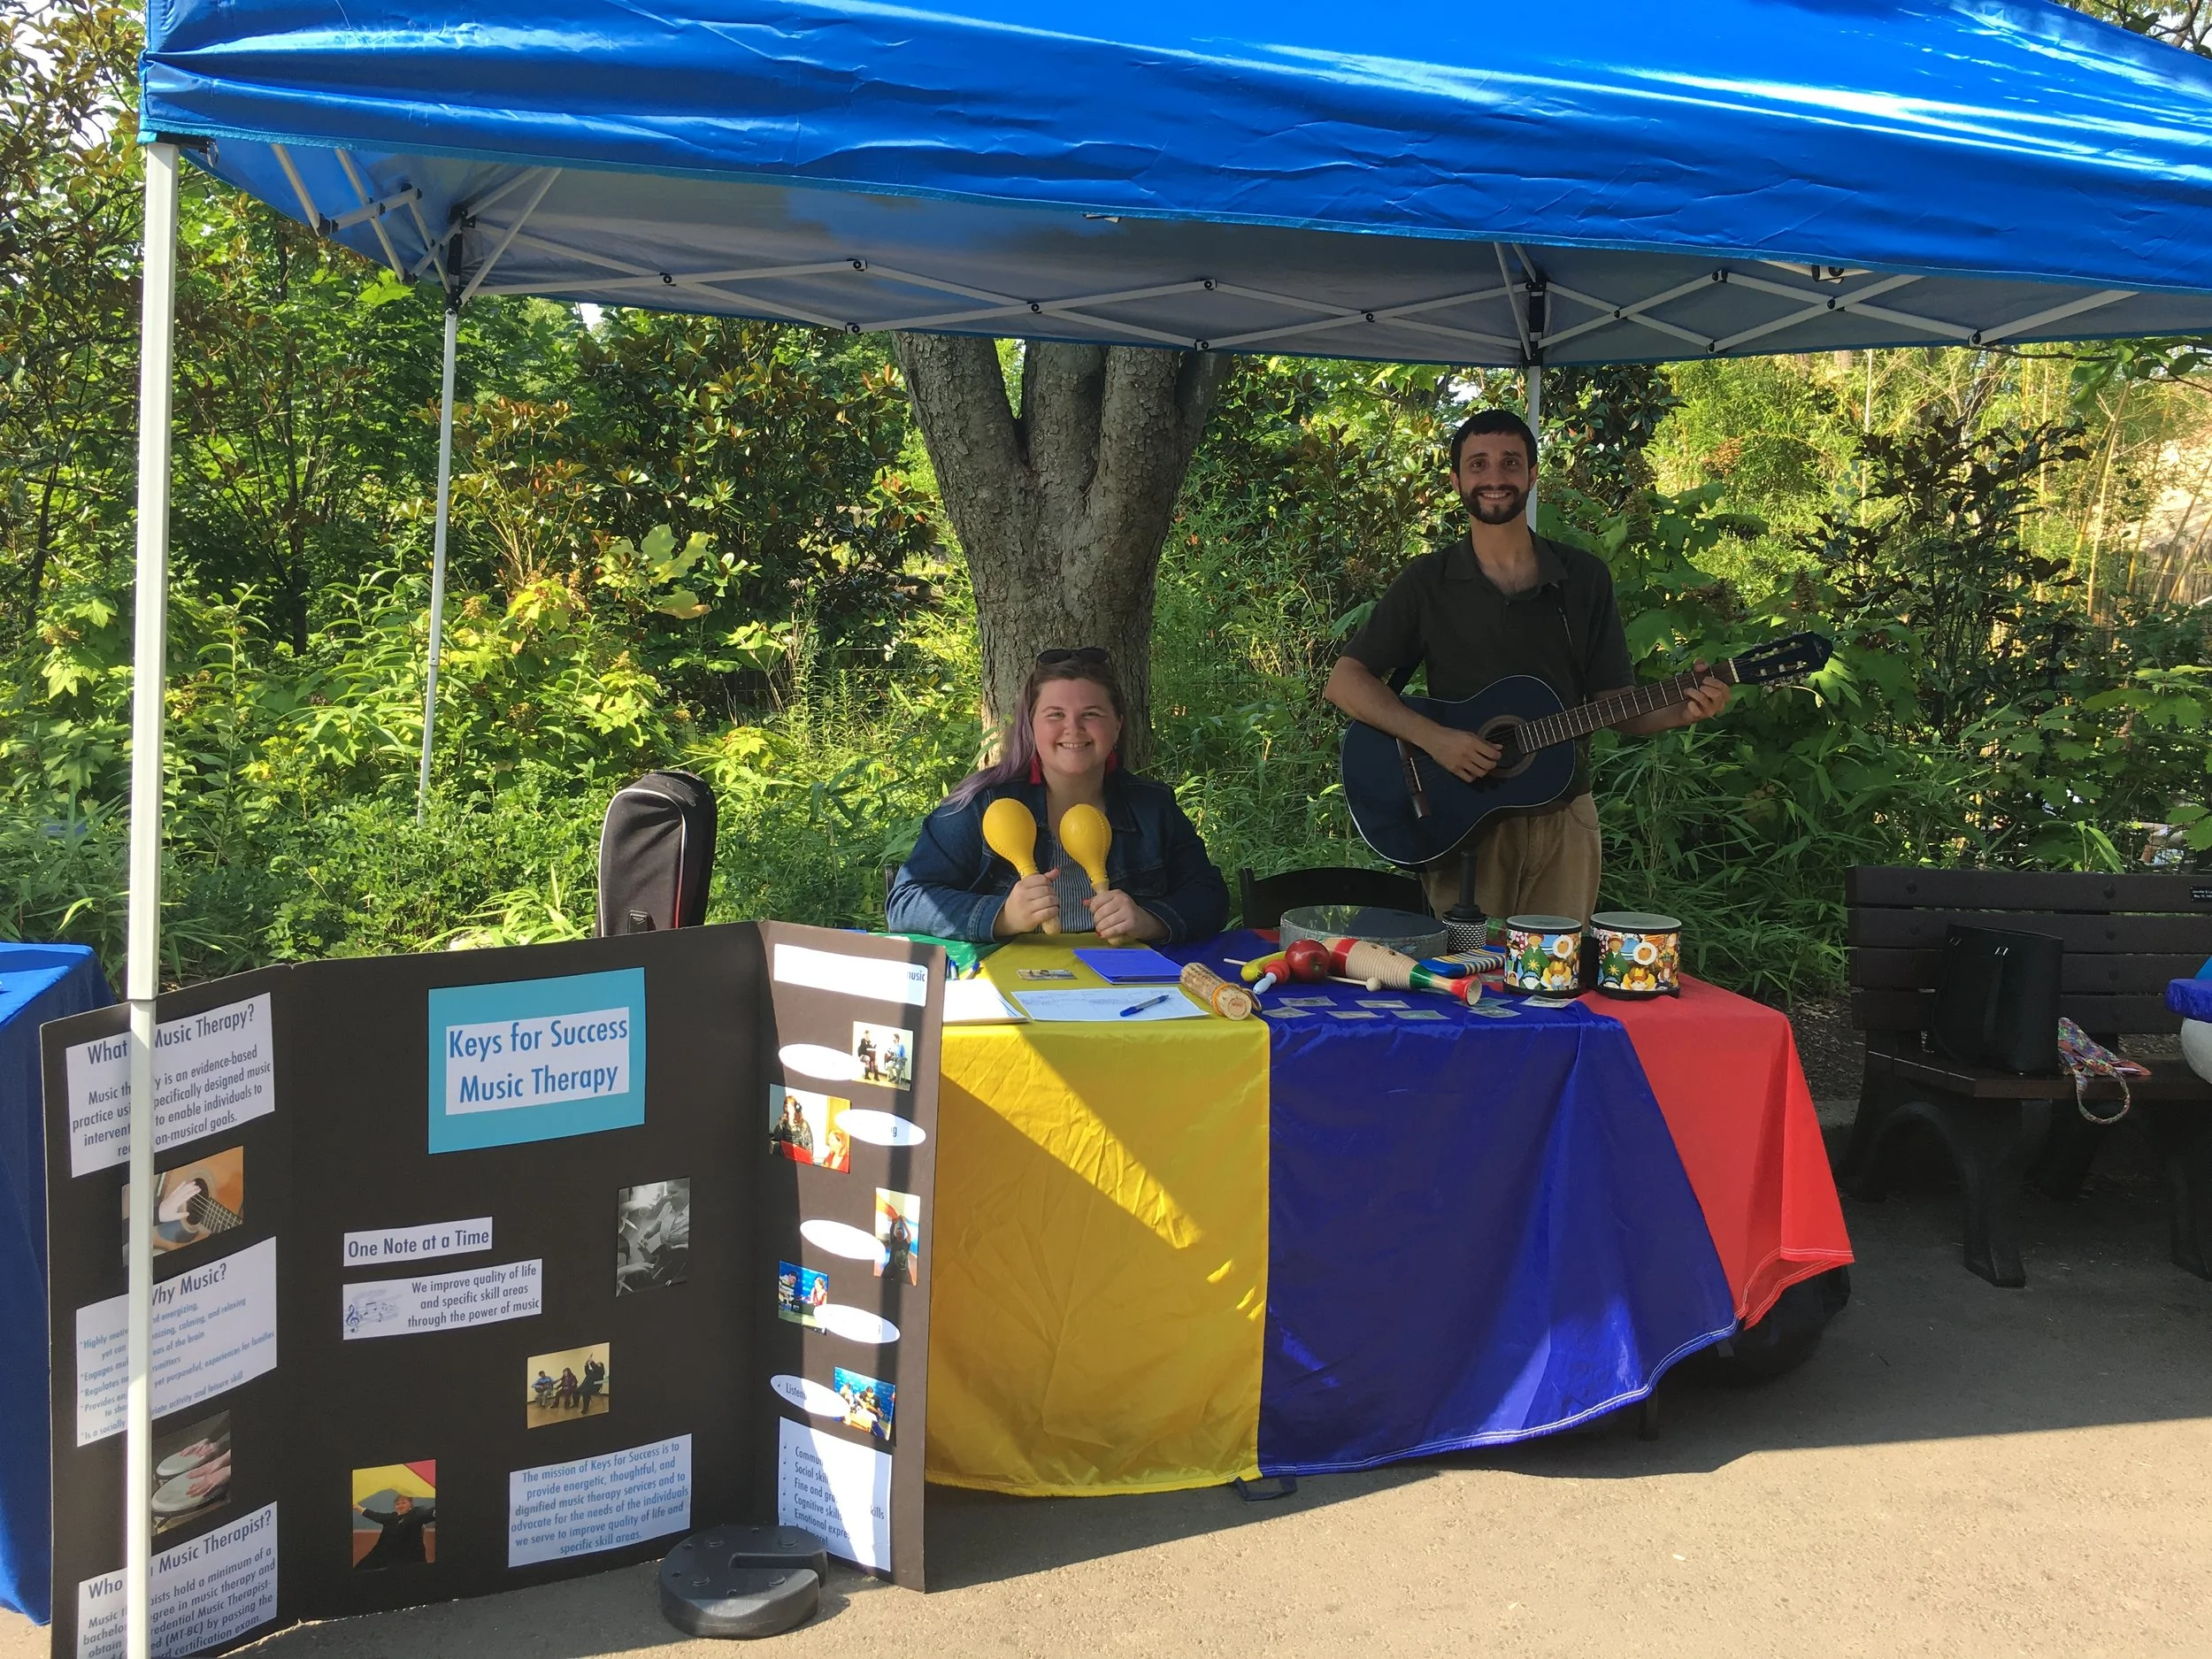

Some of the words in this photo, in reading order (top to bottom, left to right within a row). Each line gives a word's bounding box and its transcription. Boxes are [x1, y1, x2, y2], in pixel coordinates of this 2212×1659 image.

[88, 1040, 127, 1064] What
[196, 1003, 255, 1038] Therapy?
[449, 1030, 502, 1062] Keys
[511, 1022, 542, 1052] for
[550, 1019, 627, 1048] Success
[88, 1087, 118, 1105] Music
[164, 1072, 173, 1086] is
[176, 1071, 188, 1083] an
[190, 1045, 257, 1078] evidence-based
[459, 1072, 524, 1103] Music
[531, 1064, 618, 1094] Therapy
[73, 1110, 113, 1133] practice
[117, 1102, 131, 1117] usi
[154, 1083, 202, 1110] pecifically
[204, 1067, 244, 1094] designed
[247, 1062, 271, 1079] music
[84, 1123, 130, 1147] intervent
[155, 1115, 165, 1126] to
[168, 1100, 202, 1125] enable
[204, 1087, 251, 1112] individuals
[254, 1084, 262, 1095] to
[155, 1115, 208, 1146] on-musical
[210, 1110, 237, 1132] goals.
[348, 1240, 378, 1257] One
[384, 1238, 417, 1255] Note
[422, 1235, 436, 1251] at
[442, 1237, 449, 1248] a
[455, 1230, 489, 1247] Time
[180, 1263, 227, 1295] Music?
[411, 1281, 427, 1294] We
[430, 1277, 470, 1295] improve
[473, 1270, 506, 1289] quality
[509, 1267, 519, 1279] of
[522, 1263, 536, 1278] life
[420, 1295, 439, 1310] and
[442, 1292, 478, 1311] specific
[480, 1287, 500, 1301] skill
[503, 1285, 528, 1298] areas
[114, 1344, 127, 1354] can
[208, 1306, 220, 1319] and
[408, 1310, 447, 1328] through
[449, 1310, 465, 1322] the
[469, 1305, 497, 1323] power
[500, 1302, 511, 1314] of
[513, 1297, 540, 1312] music
[84, 1365, 113, 1381] Engages
[166, 1340, 173, 1351] of
[175, 1338, 186, 1348] the
[188, 1331, 204, 1344] brain
[85, 1382, 119, 1397] Regulates
[85, 1397, 115, 1412] Provides
[154, 1377, 165, 1389] yet
[523, 1471, 538, 1483] The
[541, 1465, 576, 1480] mission
[579, 1461, 588, 1473] of
[591, 1459, 611, 1473] Keys
[613, 1453, 626, 1467] for
[629, 1448, 660, 1463] Success
[662, 1444, 669, 1455] is
[671, 1442, 680, 1452] to
[526, 1482, 561, 1501] provide
[564, 1475, 607, 1493] energetic,
[611, 1462, 657, 1483] thoughtful,
[659, 1458, 676, 1471] and
[795, 1462, 813, 1479] Social
[515, 1500, 556, 1517] dignified
[559, 1493, 584, 1508] music
[588, 1488, 621, 1504] therapy
[624, 1481, 657, 1495] services
[658, 1475, 675, 1486] and
[677, 1472, 686, 1482] to
[795, 1477, 808, 1492] Fine
[810, 1486, 822, 1497] and
[795, 1494, 824, 1514] Cognitive
[511, 1517, 552, 1533] advocate
[555, 1512, 568, 1524] for
[571, 1509, 585, 1522] the
[587, 1506, 613, 1518] needs
[616, 1501, 625, 1513] of
[627, 1498, 641, 1509] the
[643, 1486, 688, 1506] individuals
[516, 1537, 528, 1548] we
[531, 1532, 556, 1545] serve
[558, 1529, 567, 1540] to
[569, 1523, 606, 1540] improve
[608, 1514, 639, 1531] quality
[641, 1510, 650, 1522] of
[652, 1507, 665, 1519] life
[668, 1502, 684, 1514] and
[795, 1508, 826, 1531] Emotional
[88, 1578, 123, 1599] Who
[158, 1546, 199, 1573] Music
[204, 1509, 272, 1555] Therapist?
[559, 1539, 593, 1555] specific
[595, 1533, 613, 1547] skill
[616, 1530, 641, 1543] areas.
[88, 1611, 118, 1629] Music
[174, 1578, 195, 1597] hold
[208, 1557, 252, 1584] minimum
[255, 1547, 264, 1563] of
[266, 1548, 272, 1557] a
[179, 1601, 188, 1611] in
[191, 1586, 218, 1606] music
[221, 1570, 256, 1594] therapy
[258, 1558, 275, 1576] and
[88, 1640, 122, 1658] obtain
[150, 1610, 194, 1635] redential
[197, 1601, 224, 1618] Music
[165, 1621, 204, 1647] (MT-BC)
[207, 1617, 219, 1632] by
[223, 1601, 256, 1626] passing
[259, 1594, 273, 1609] the
[175, 1629, 232, 1655] certification
[235, 1615, 262, 1632] exam.
